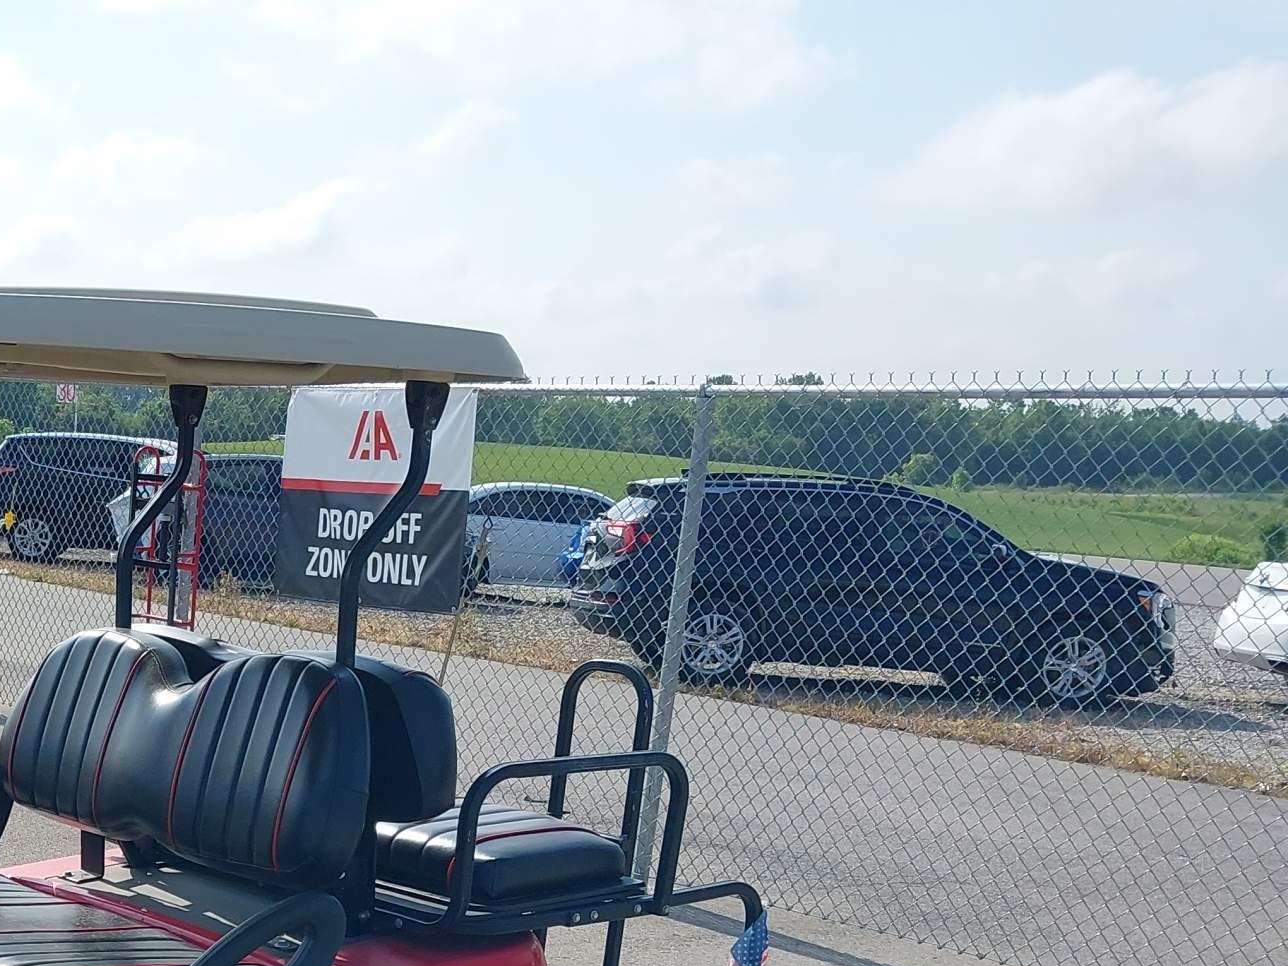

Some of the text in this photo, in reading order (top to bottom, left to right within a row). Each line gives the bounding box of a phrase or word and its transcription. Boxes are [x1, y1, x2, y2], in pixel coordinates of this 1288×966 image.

[317, 507, 374, 542] DROP
[305, 546, 428, 586] ZON ONLY
